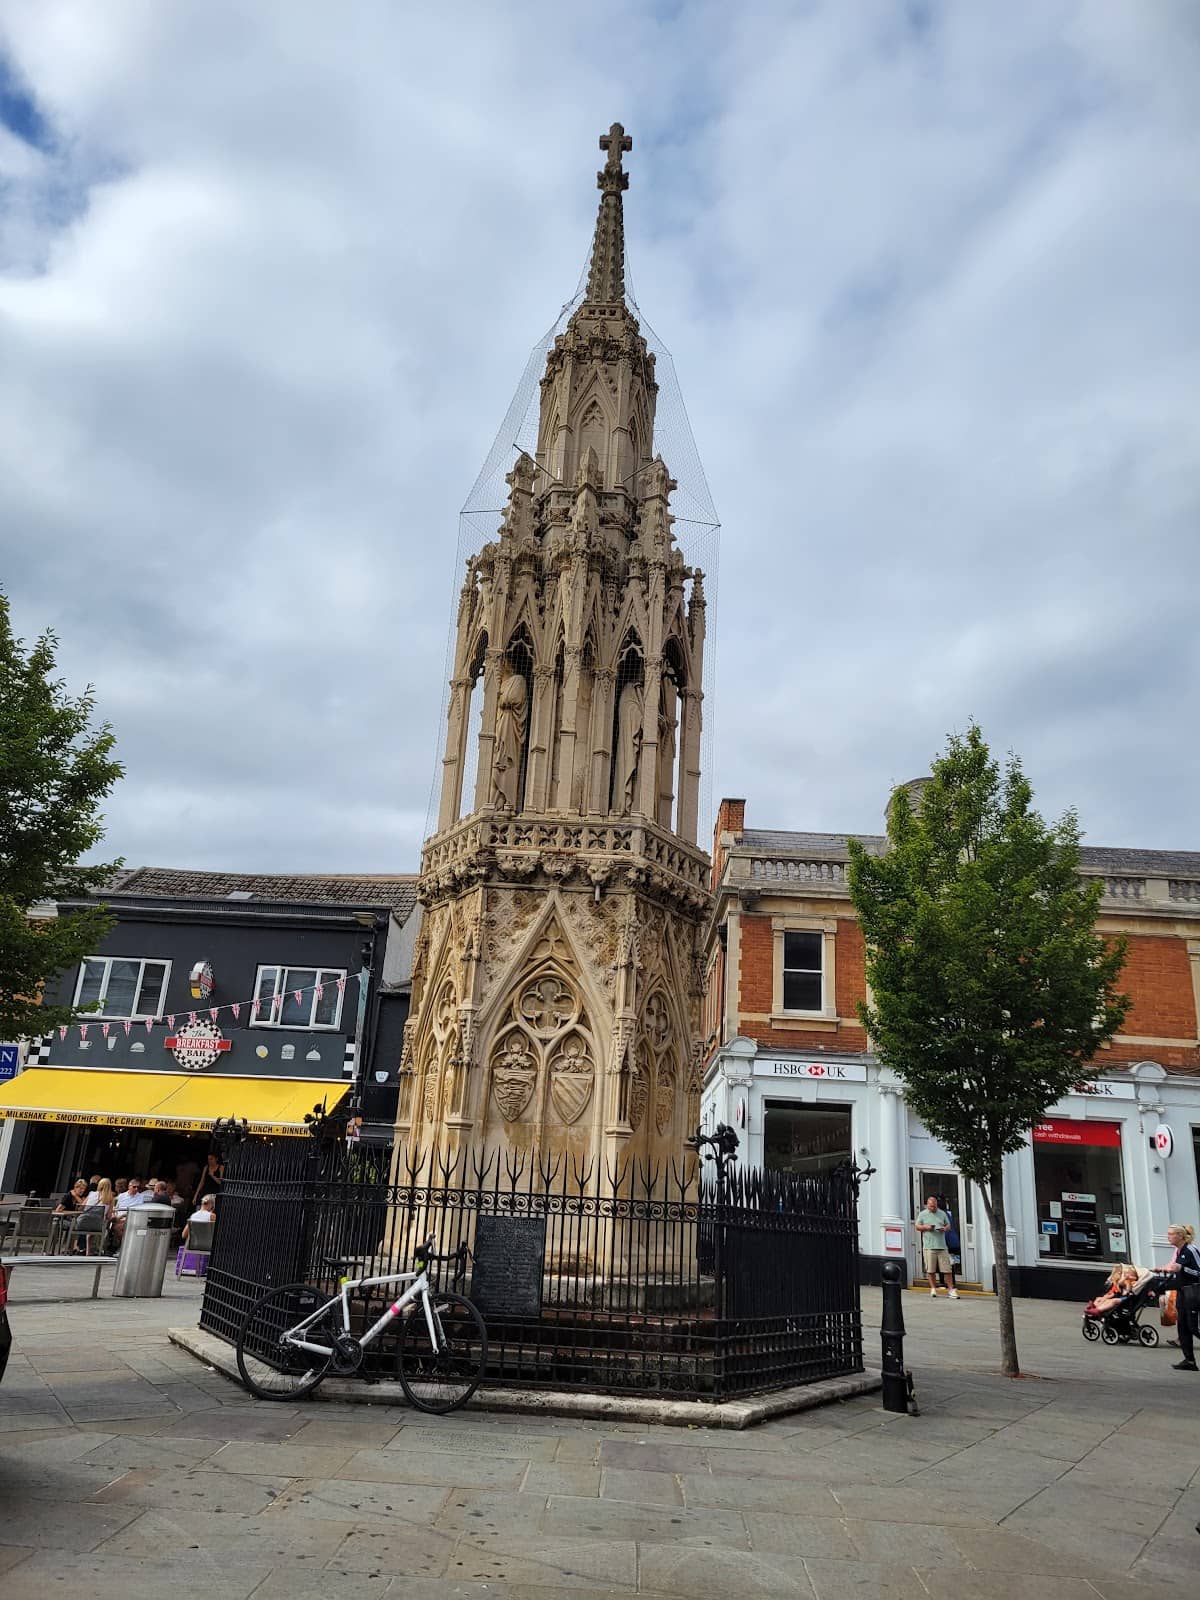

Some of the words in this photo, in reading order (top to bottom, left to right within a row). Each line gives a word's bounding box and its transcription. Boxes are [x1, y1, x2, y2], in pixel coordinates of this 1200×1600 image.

[191, 1030, 206, 1038] The
[176, 1038, 219, 1049] BREAKFAST
[773, 1063, 807, 1076] HSBC
[827, 1066, 846, 1078] UK
[5, 1110, 47, 1120] MILKSHAKE
[56, 1113, 98, 1123] SMOOTHIES
[107, 1116, 118, 1124] ICE
[121, 1117, 146, 1126] CREAM
[155, 1119, 192, 1129] PANCAKES
